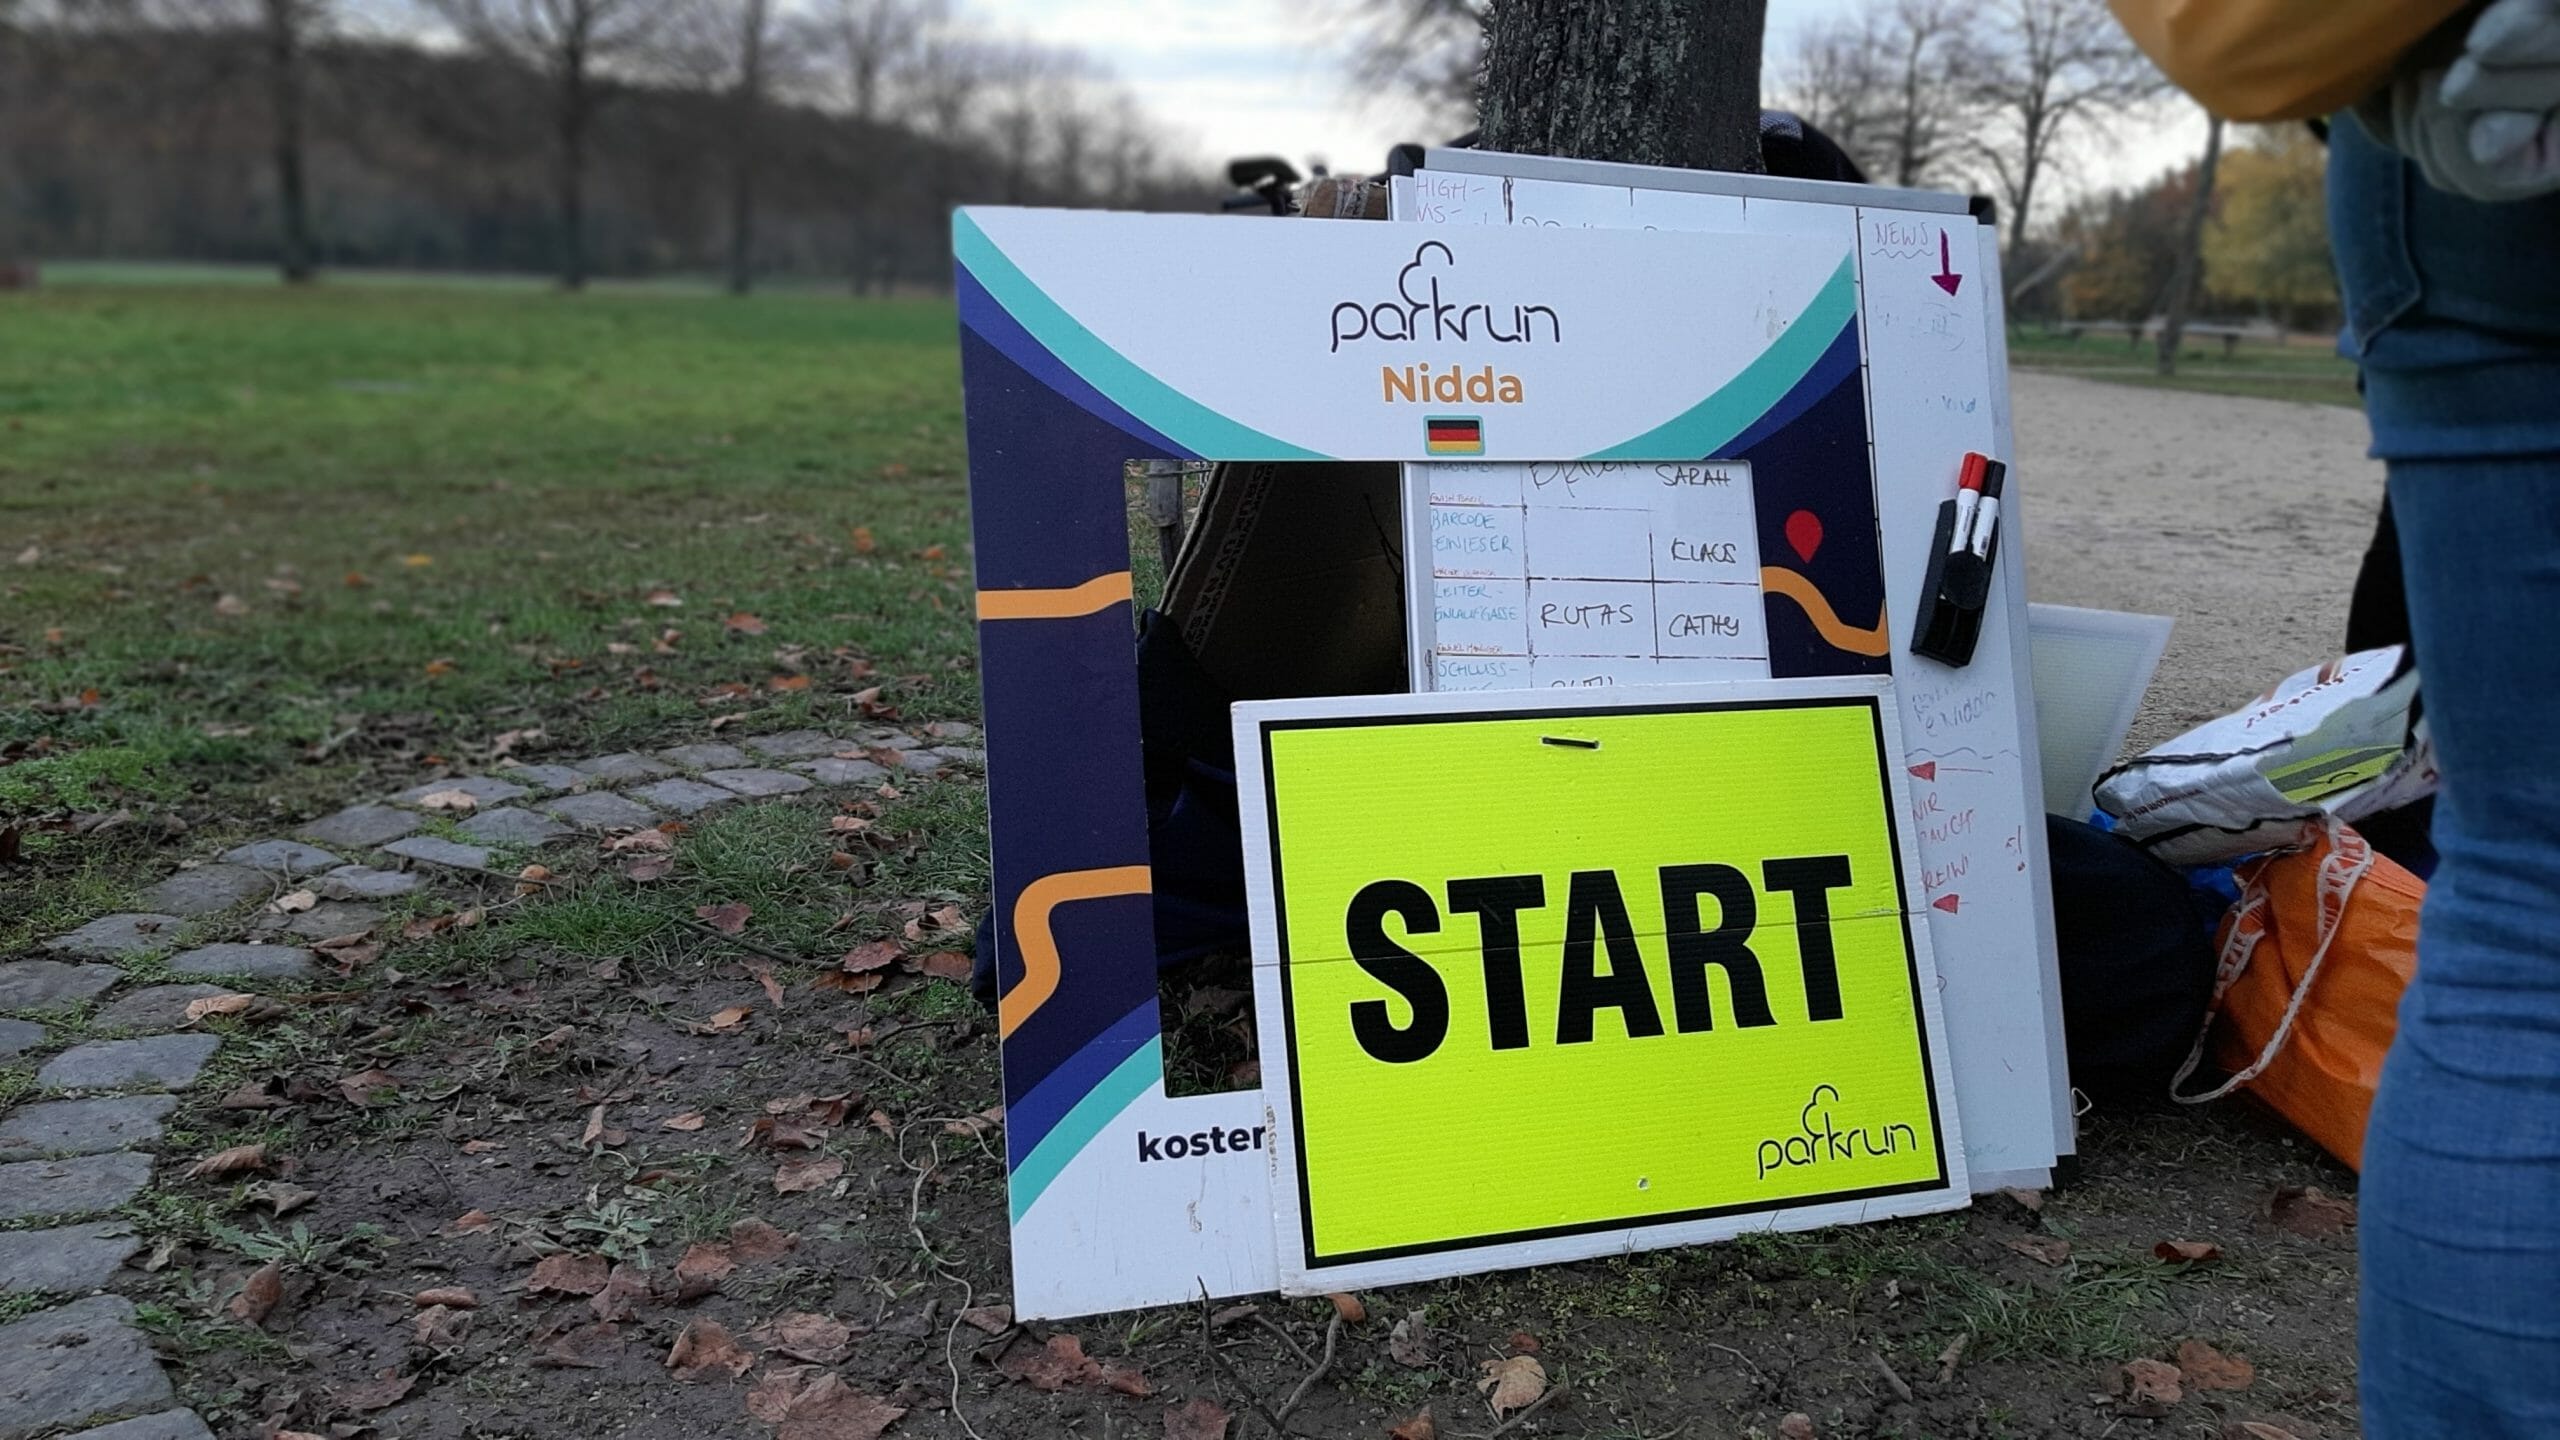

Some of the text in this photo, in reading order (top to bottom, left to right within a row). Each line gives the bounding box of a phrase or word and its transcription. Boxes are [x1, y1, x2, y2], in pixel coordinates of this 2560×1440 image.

[1875, 222, 1930, 246] NEWS
[1330, 240, 1562, 353] parkrun
[1381, 362, 1524, 404] Nidda
[1655, 463, 1732, 488] SARAH
[1346, 854, 1853, 1065] START
[1757, 1083, 1917, 1181] parkrun
